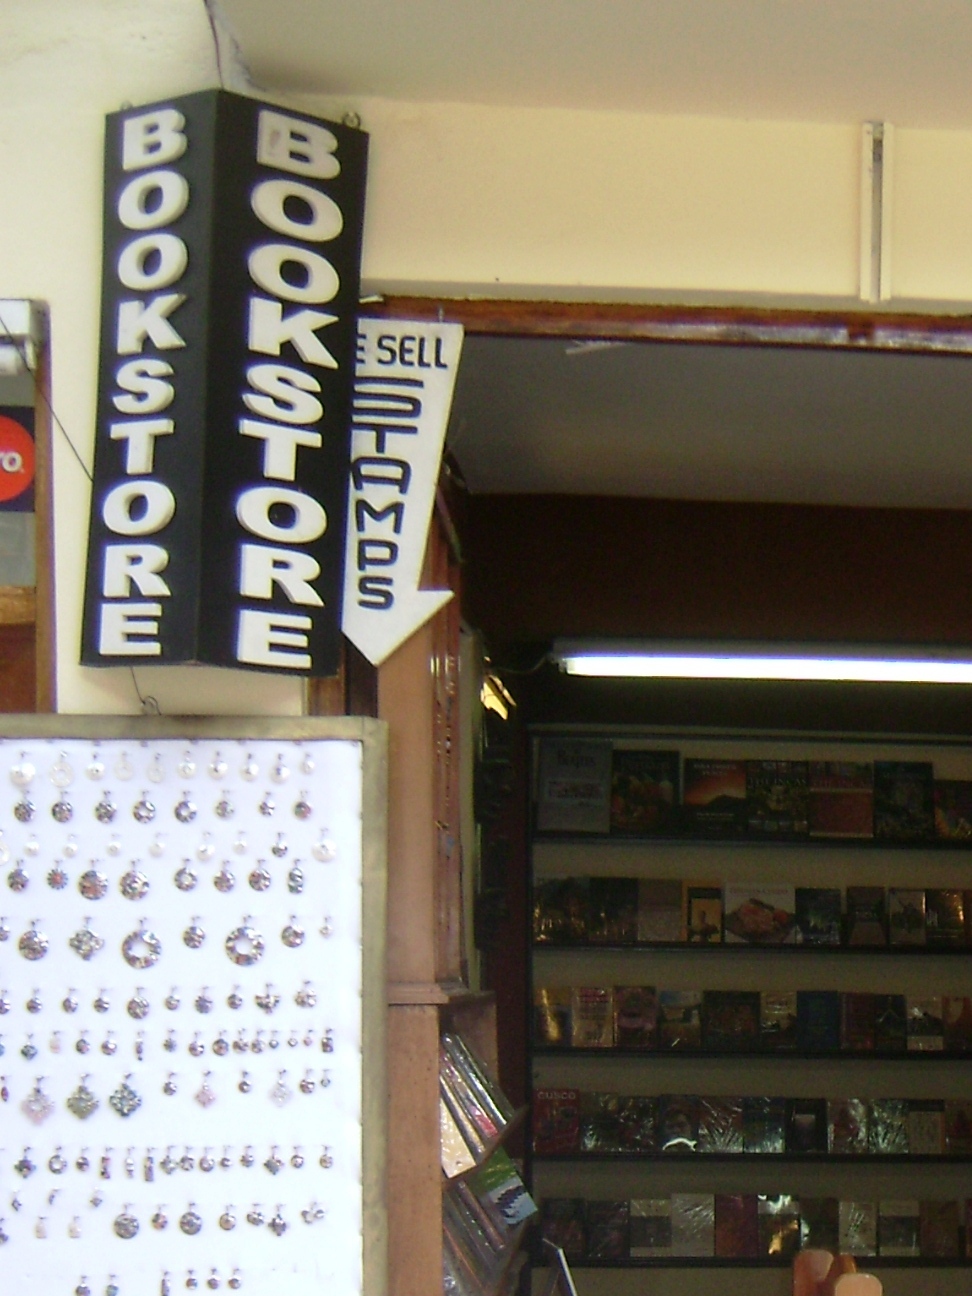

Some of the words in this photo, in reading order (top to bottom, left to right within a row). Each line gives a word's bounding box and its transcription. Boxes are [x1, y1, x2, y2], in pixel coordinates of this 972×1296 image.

[99, 107, 189, 656] BOOKSTORE
[236, 109, 344, 669] BOOKSTORE
[351, 375, 425, 611] STAMPS
[376, 334, 448, 369] SELL
